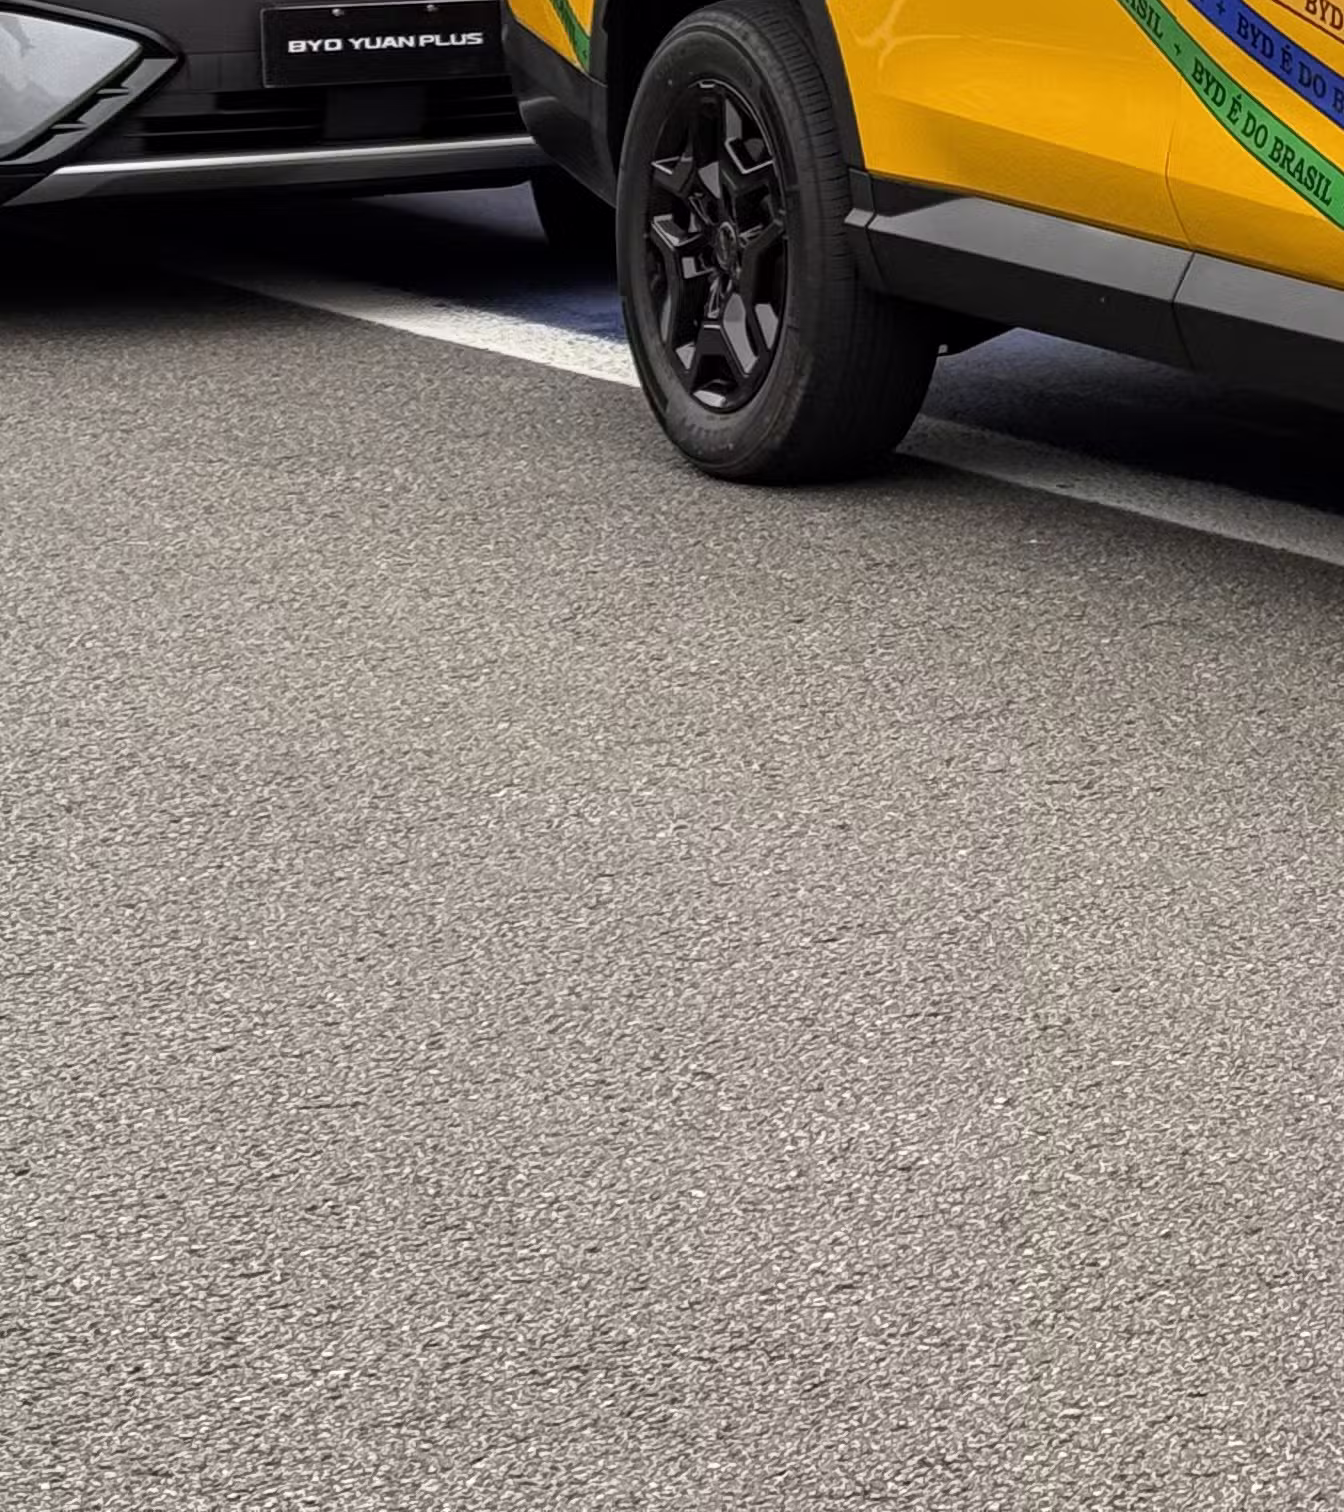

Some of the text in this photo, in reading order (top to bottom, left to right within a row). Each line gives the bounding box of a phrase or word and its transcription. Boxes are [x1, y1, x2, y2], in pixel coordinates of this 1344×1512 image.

[287, 32, 484, 53] BYD YUAN PLUS
[1236, 12, 1282, 59] BYD
[1280, 40, 1296, 75] É
[1298, 62, 1328, 99] DO
[1191, 56, 1226, 107] BYD
[1223, 91, 1242, 125] É
[1240, 111, 1268, 149] DO
[1268, 136, 1332, 205] BRASIL
